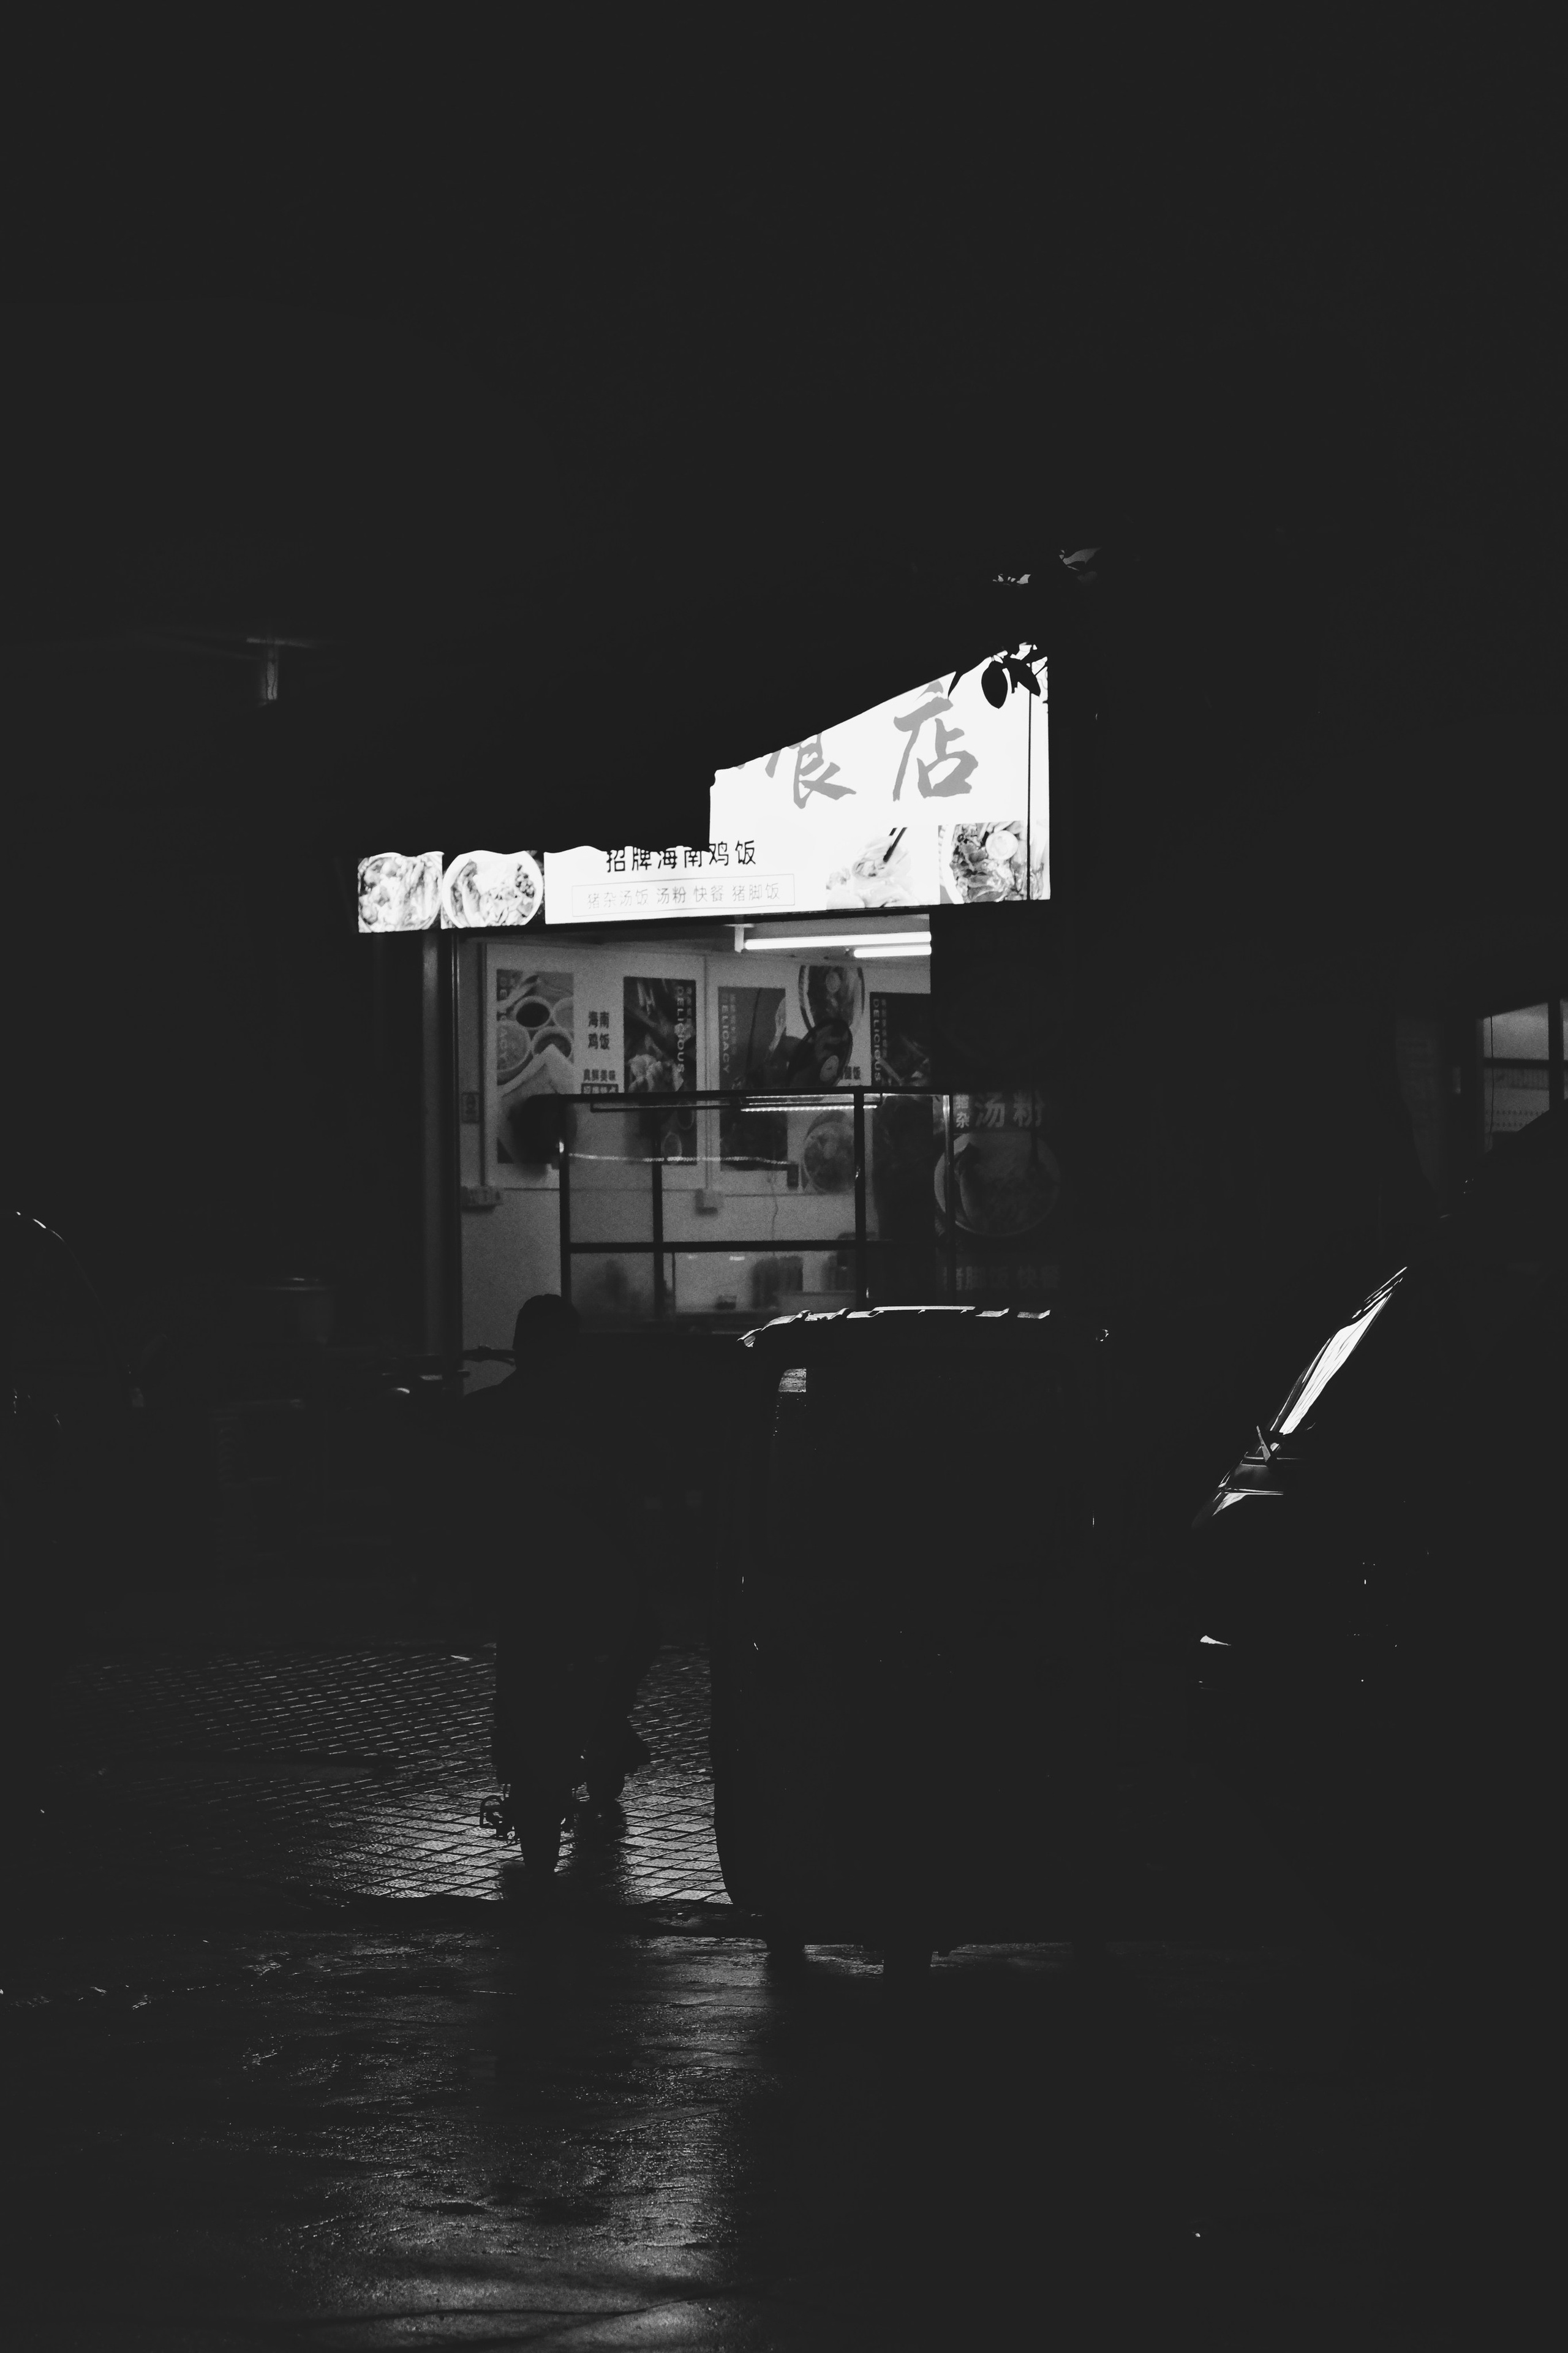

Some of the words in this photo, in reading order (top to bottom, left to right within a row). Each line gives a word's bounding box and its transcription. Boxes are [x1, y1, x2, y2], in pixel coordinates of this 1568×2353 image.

[606, 840, 756, 873] 招牌海南鸡饭
[587, 888, 649, 909] 猪杂汤饭
[657, 886, 687, 904] 汤粉
[693, 885, 724, 903] 快餐
[732, 882, 780, 902] 猪脚饭
